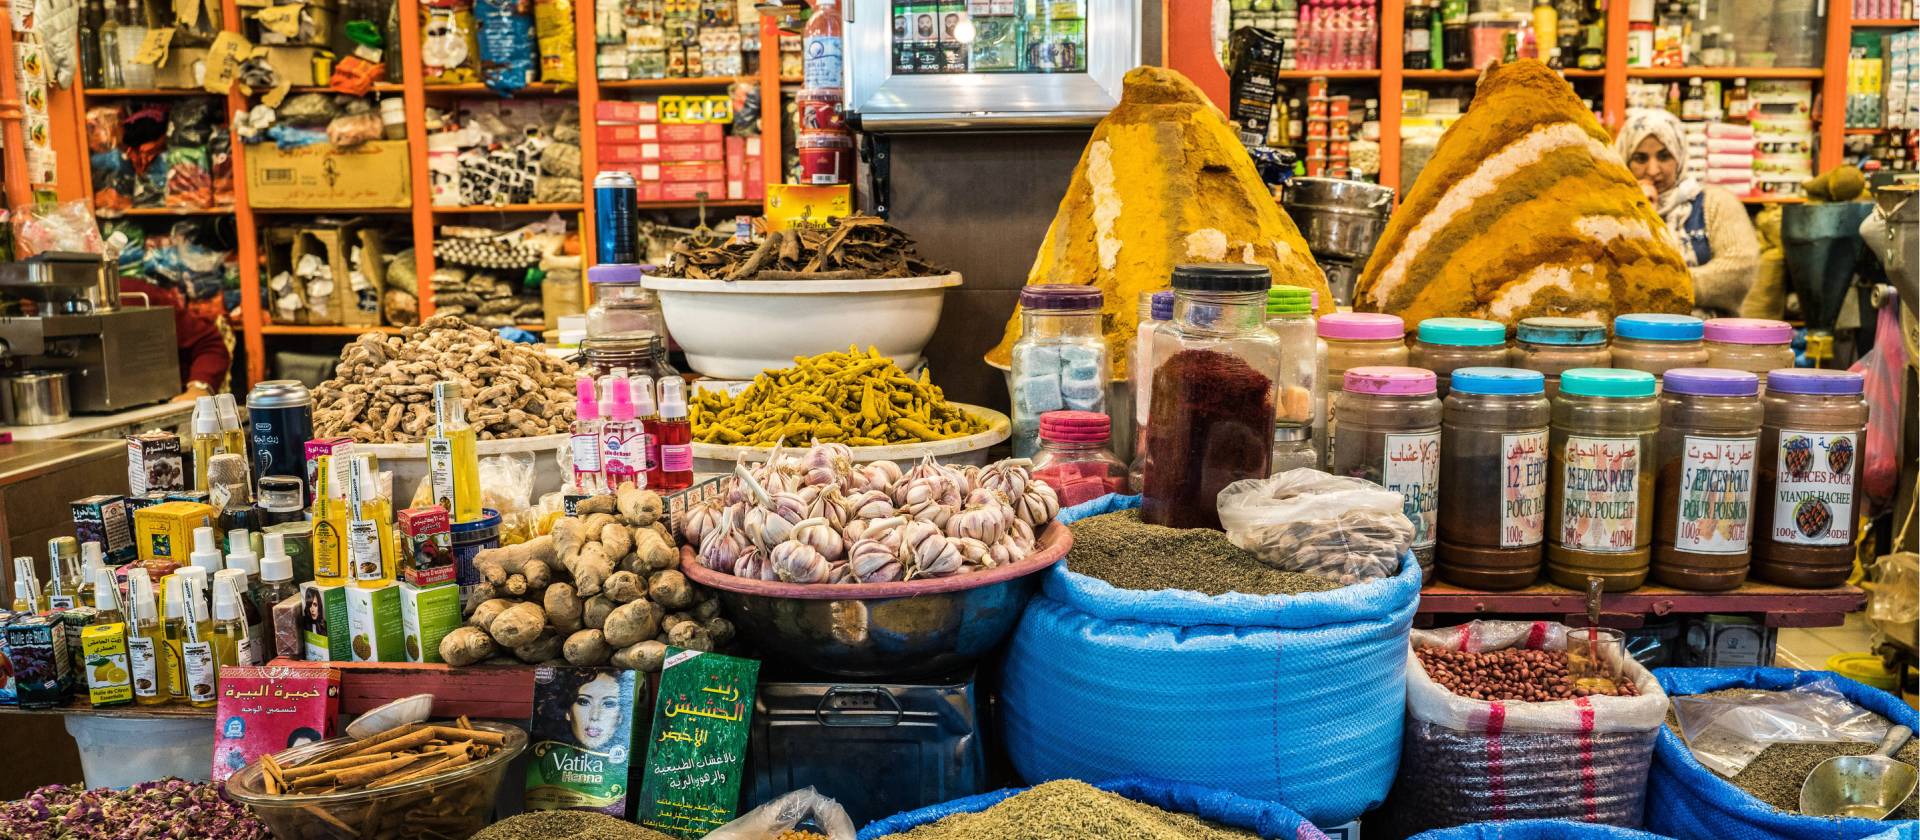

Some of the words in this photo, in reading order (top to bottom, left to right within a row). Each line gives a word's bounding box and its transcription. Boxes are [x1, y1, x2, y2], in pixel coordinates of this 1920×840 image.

[1688, 445, 1722, 464] الحوت
[1725, 444, 1752, 465] عطرية
[1507, 464, 1520, 488] 12
[1577, 468, 1609, 492] EPICES
[1610, 469, 1634, 493] POUR
[1684, 467, 1693, 490] 5
[1694, 468, 1728, 492] EPICES
[1780, 471, 1790, 483] 12
[1791, 472, 1827, 483] EPICES
[1829, 473, 1851, 485] POUR
[1780, 491, 1816, 503] VIANDE
[1818, 491, 1850, 504] HACHEE
[1506, 499, 1532, 518] POUR
[1595, 501, 1635, 520] POULET
[1683, 499, 1711, 520] POUR
[1681, 521, 1701, 544] 100g
[1776, 527, 1797, 540] 100g
[225, 684, 269, 700] البيرة
[274, 684, 320, 701] خميرة
[702, 674, 739, 702] زيت
[665, 694, 745, 722] الحشيش
[657, 726, 708, 748] الأخضر
[552, 752, 604, 772] Vatika
[561, 771, 604, 783] Henna
